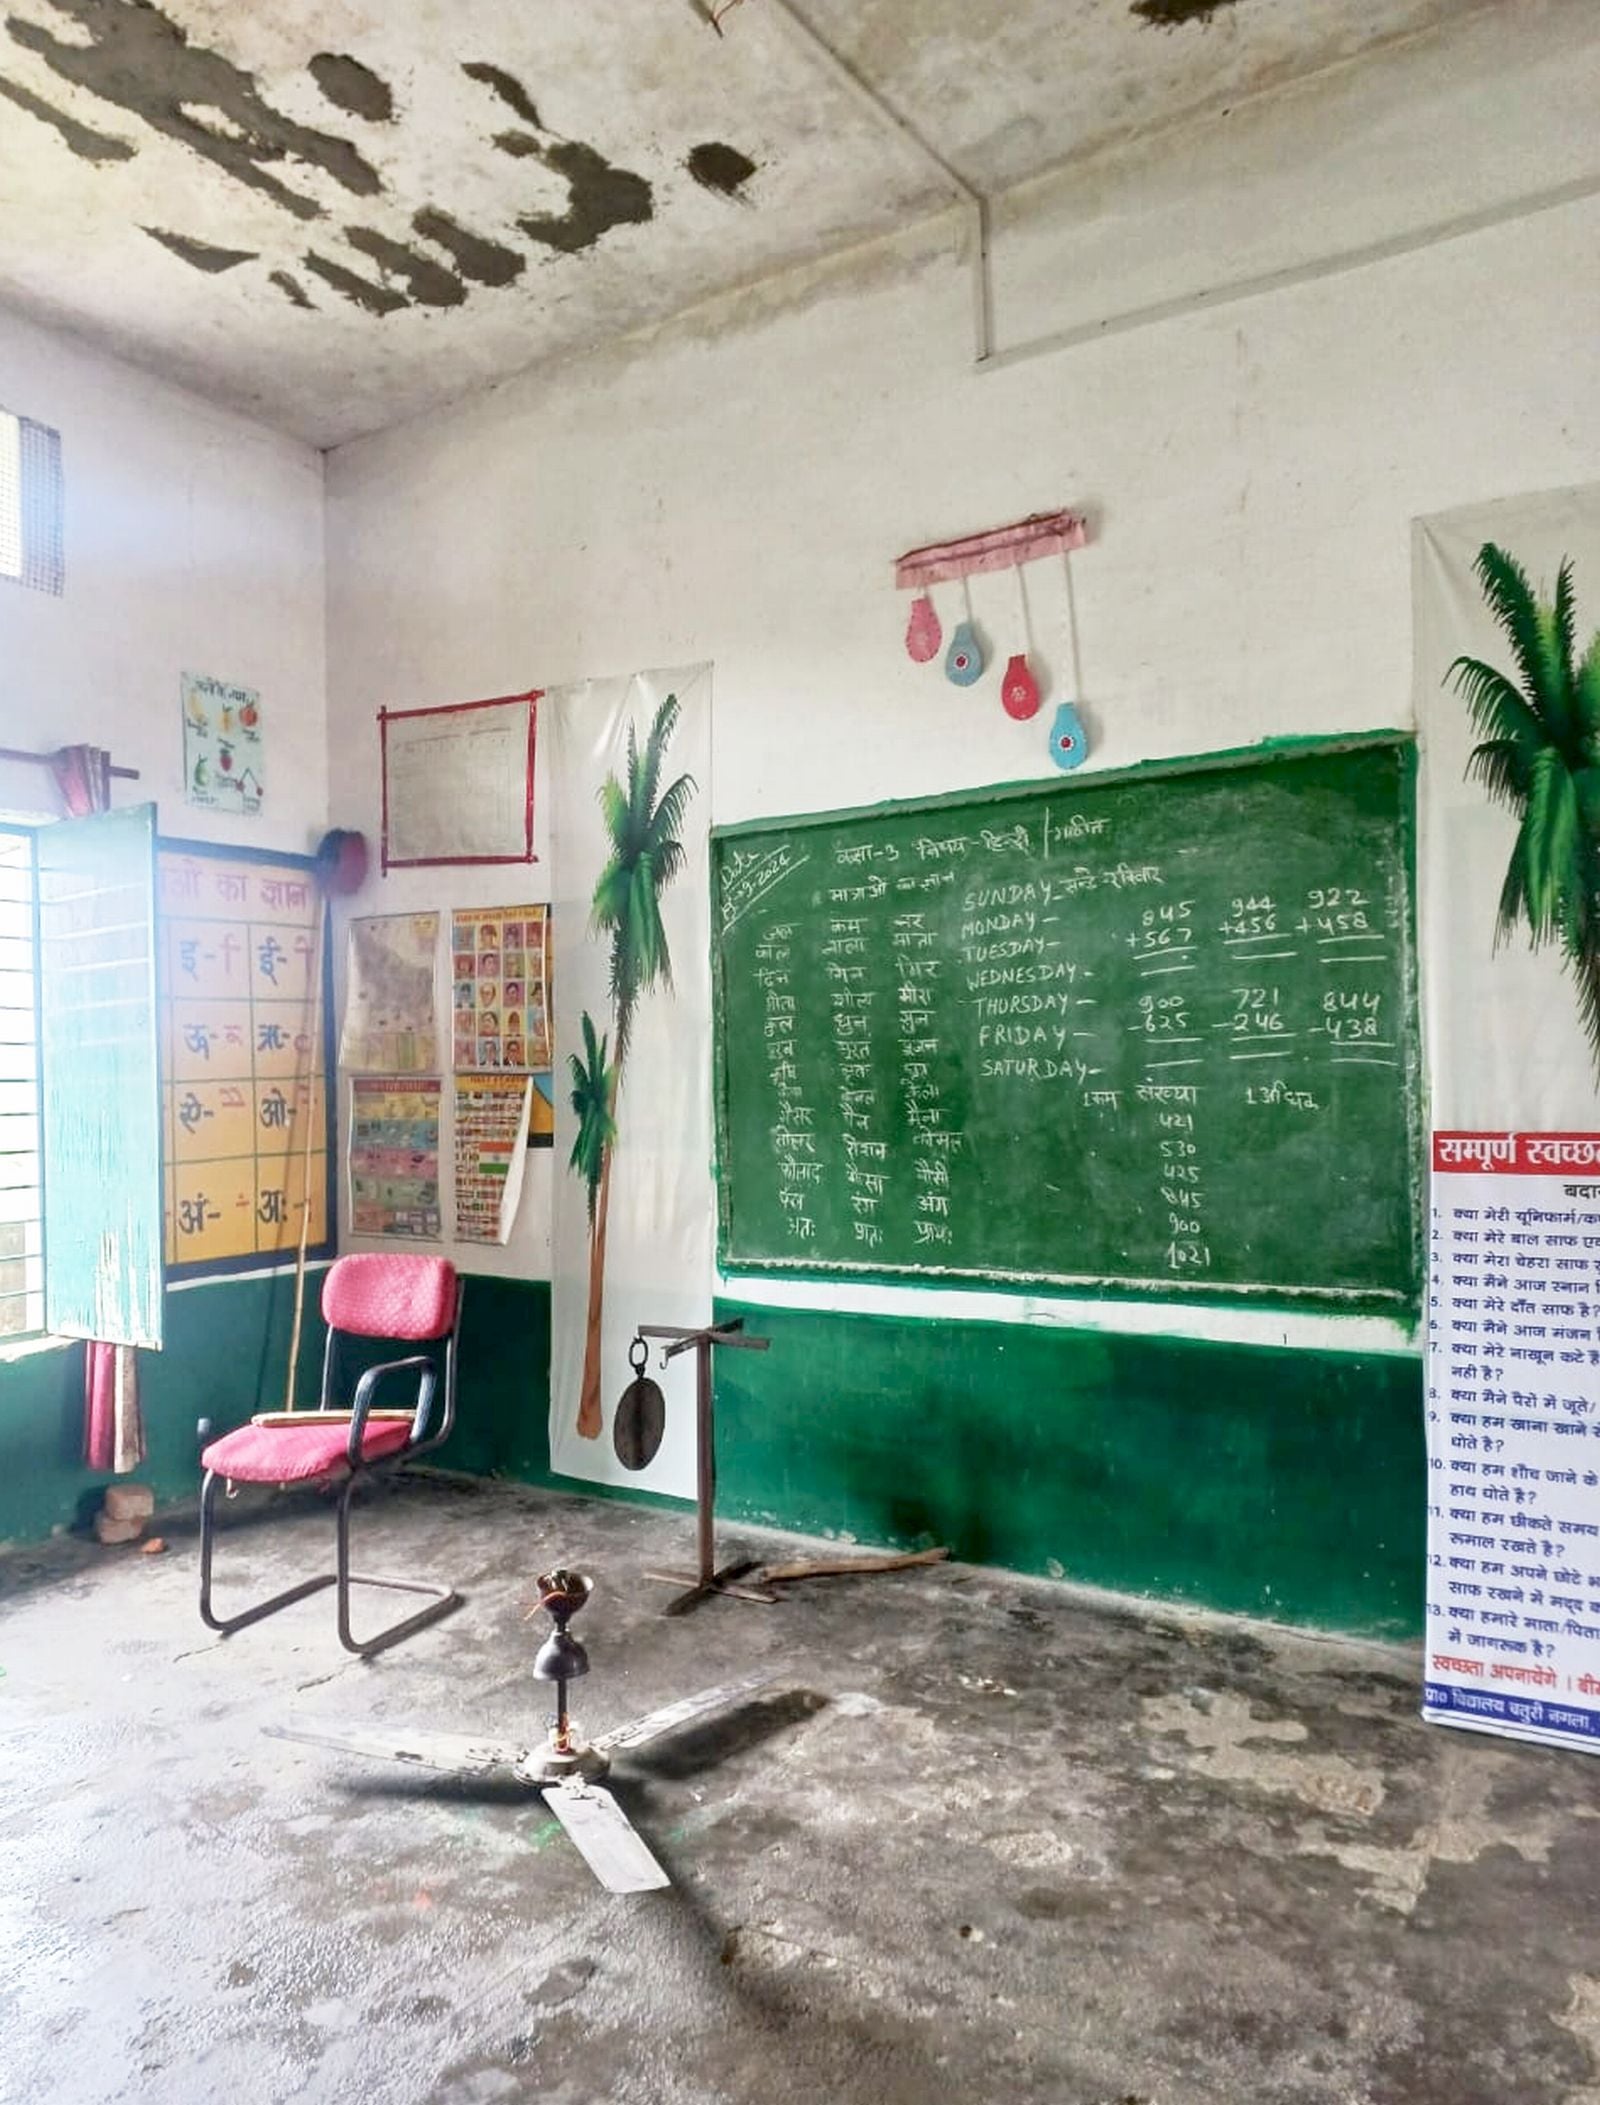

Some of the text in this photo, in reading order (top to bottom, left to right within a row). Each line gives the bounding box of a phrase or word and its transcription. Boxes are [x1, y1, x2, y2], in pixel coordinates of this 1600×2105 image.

[1142, 900, 1198, 926] 845
[1307, 886, 1370, 909] 922
[1231, 986, 1280, 1010] 721
[1323, 991, 1382, 1015] 844
[1159, 1112, 1194, 1132] 421
[1160, 1140, 1197, 1158] 530
[1438, 1131, 1517, 1171] सम्पूर्ण
[1164, 1164, 1200, 1184] 425
[1452, 1207, 1480, 1220] क्या
[1452, 1229, 1479, 1242] क्या
[1511, 1233, 1540, 1246] बाल
[1544, 1234, 1578, 1247] साफ
[1167, 1240, 1211, 1270] 1021
[1452, 1252, 1479, 1265] क्या
[1555, 1258, 1589, 1271] साफ
[1451, 1275, 1478, 1288] क्या
[1513, 1279, 1547, 1292] आज
[1451, 1297, 1478, 1310] क्या
[1541, 1303, 1575, 1316] साफ
[1450, 1320, 1478, 1334] क्या
[1513, 1325, 1547, 1339] आज
[1450, 1343, 1477, 1357] क्या
[1450, 1388, 1477, 1402] क्या
[1449, 1412, 1477, 1426] क्या
[1481, 1415, 1505, 1429] हम
[1510, 1418, 1548, 1433] खाना
[1553, 1420, 1588, 1437] खाने
[1450, 1459, 1477, 1474] क्या
[1481, 1463, 1505, 1477] हम
[1545, 1468, 1578, 1485] जाने
[1450, 1507, 1476, 1522] क्या
[1481, 1511, 1505, 1526] हम
[1558, 1520, 1600, 1537] समय
[1449, 1556, 1476, 1571] क्या
[1480, 1560, 1505, 1575] हम
[1510, 1564, 1548, 1582] अपने
[1448, 1580, 1483, 1596] साफ
[1448, 1606, 1475, 1621] क्या
